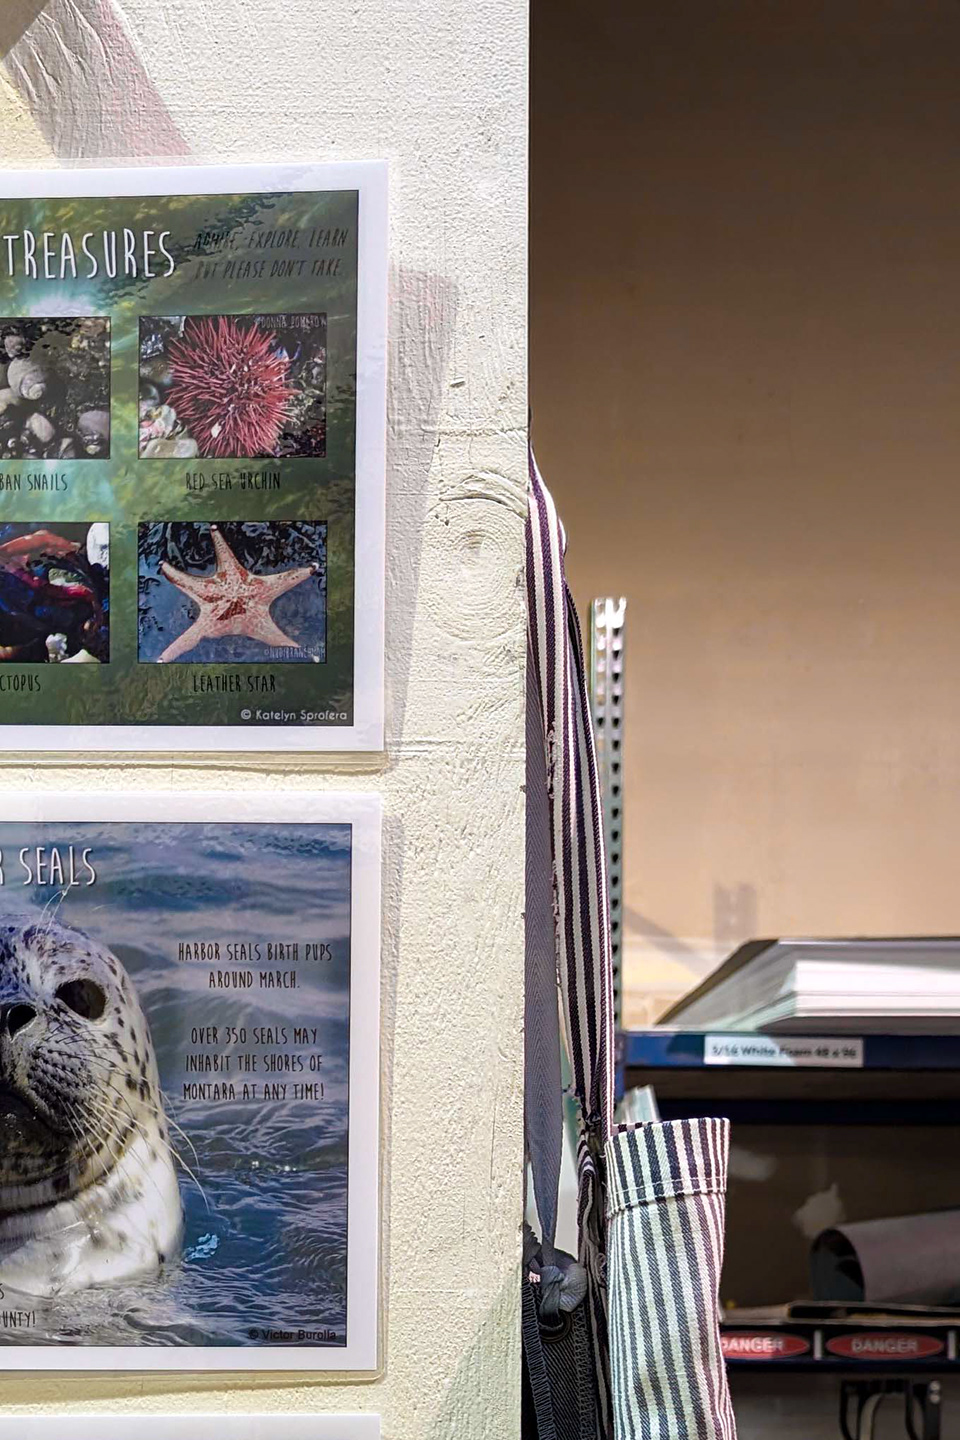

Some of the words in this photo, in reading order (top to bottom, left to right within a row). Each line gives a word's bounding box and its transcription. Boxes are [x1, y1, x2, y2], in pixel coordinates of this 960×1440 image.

[3, 228, 175, 279] TREASURES
[27, 473, 68, 491] SNAILS
[185, 471, 205, 490] RED
[212, 472, 232, 490] SEA
[240, 472, 281, 490] URCHIN
[193, 674, 240, 692] LEATHER
[247, 675, 276, 692] STAR
[256, 709, 296, 722] Katelyn
[300, 709, 348, 722] Sprofera
[19, 845, 97, 885] SEALS
[178, 942, 221, 961] HARBOR
[226, 943, 262, 961] SEALS
[267, 943, 299, 961] BIRTH
[305, 944, 332, 961] PUPS
[209, 971, 253, 988] AROUND
[259, 971, 300, 988] MARCH.
[191, 1027, 218, 1044] OVER
[225, 1027, 247, 1044] 350
[253, 1027, 288, 1044] SEALS
[294, 1028, 317, 1044] MAY
[186, 1055, 231, 1072] INHABIT
[237, 1055, 257, 1072] THE
[263, 1055, 304, 1072] SHORES
[309, 1055, 323, 1072] OF
[183, 1083, 235, 1100] MONTARA
[243, 1083, 257, 1100] AT
[263, 1083, 287, 1100] ANY
[293, 1083, 324, 1100] TIME!
[261, 1329, 293, 1340] Victor
[851, 1338, 918, 1352] DANGER
